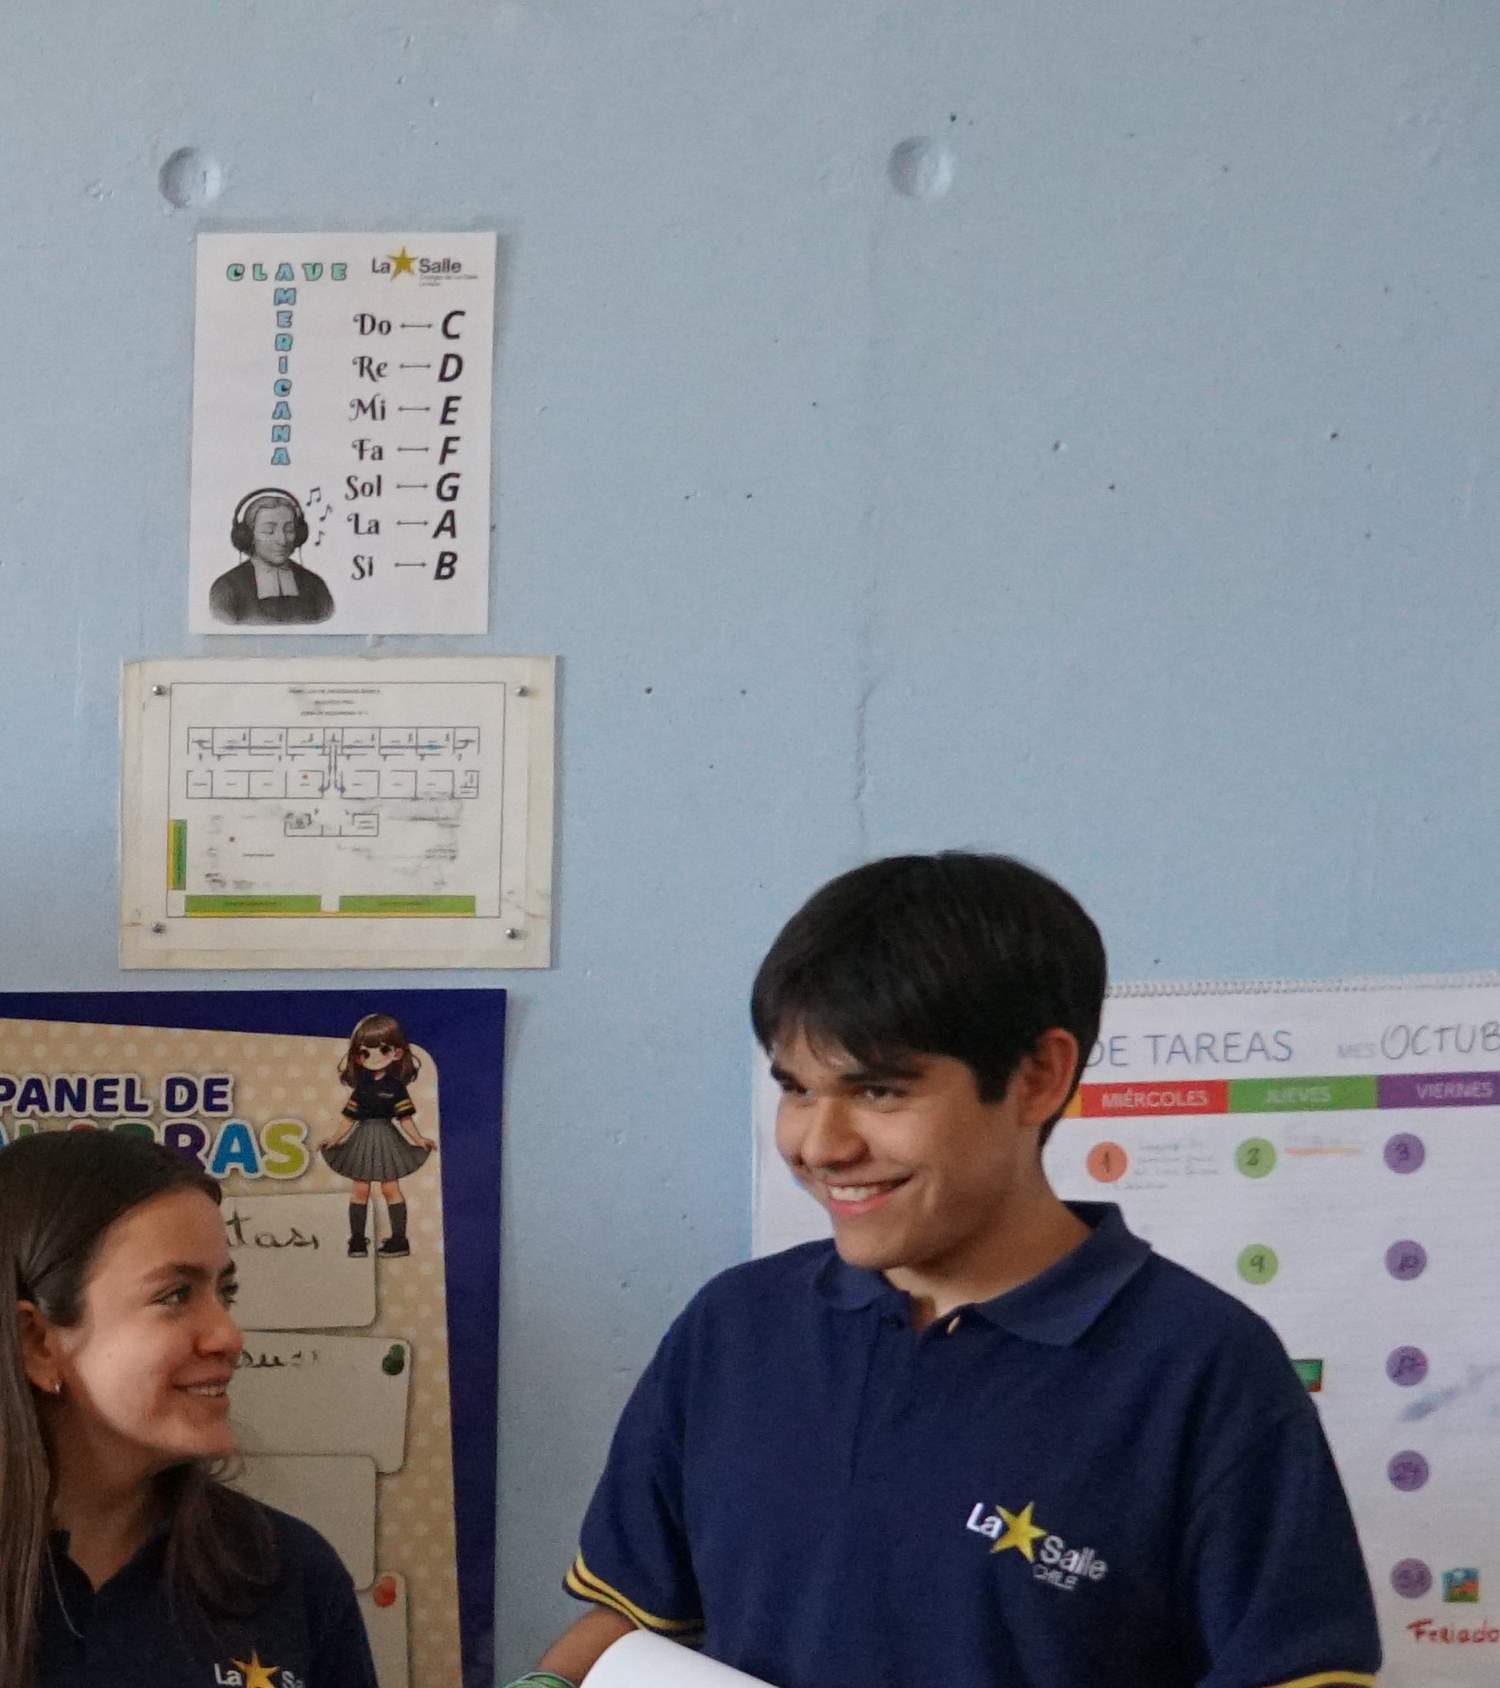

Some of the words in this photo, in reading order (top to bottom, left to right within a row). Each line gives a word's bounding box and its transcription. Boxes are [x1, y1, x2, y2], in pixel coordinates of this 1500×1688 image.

[226, 263, 348, 282] CLAVE
[371, 257, 391, 273] La
[419, 257, 462, 273] Salle
[353, 312, 392, 336] Do
[441, 310, 466, 340] C
[352, 355, 389, 382] Re
[437, 353, 464, 383] D
[348, 393, 387, 422] Mi
[439, 395, 462, 426] E
[352, 438, 384, 461] Fa
[438, 436, 461, 466] F
[344, 475, 382, 501] Sol
[435, 472, 461, 502] G
[346, 512, 380, 536] La
[432, 509, 458, 539] A
[433, 551, 458, 581] B
[1143, 1030, 1293, 1065] TAREAS
[164, 1076, 232, 1114] DE
[1101, 1087, 1209, 1109] MIÉRCOLES
[1415, 1081, 1495, 1101] VIERNES
[966, 1502, 1004, 1539] La
[1040, 1535, 1109, 1581] Salle
[213, 1663, 243, 1687] La
